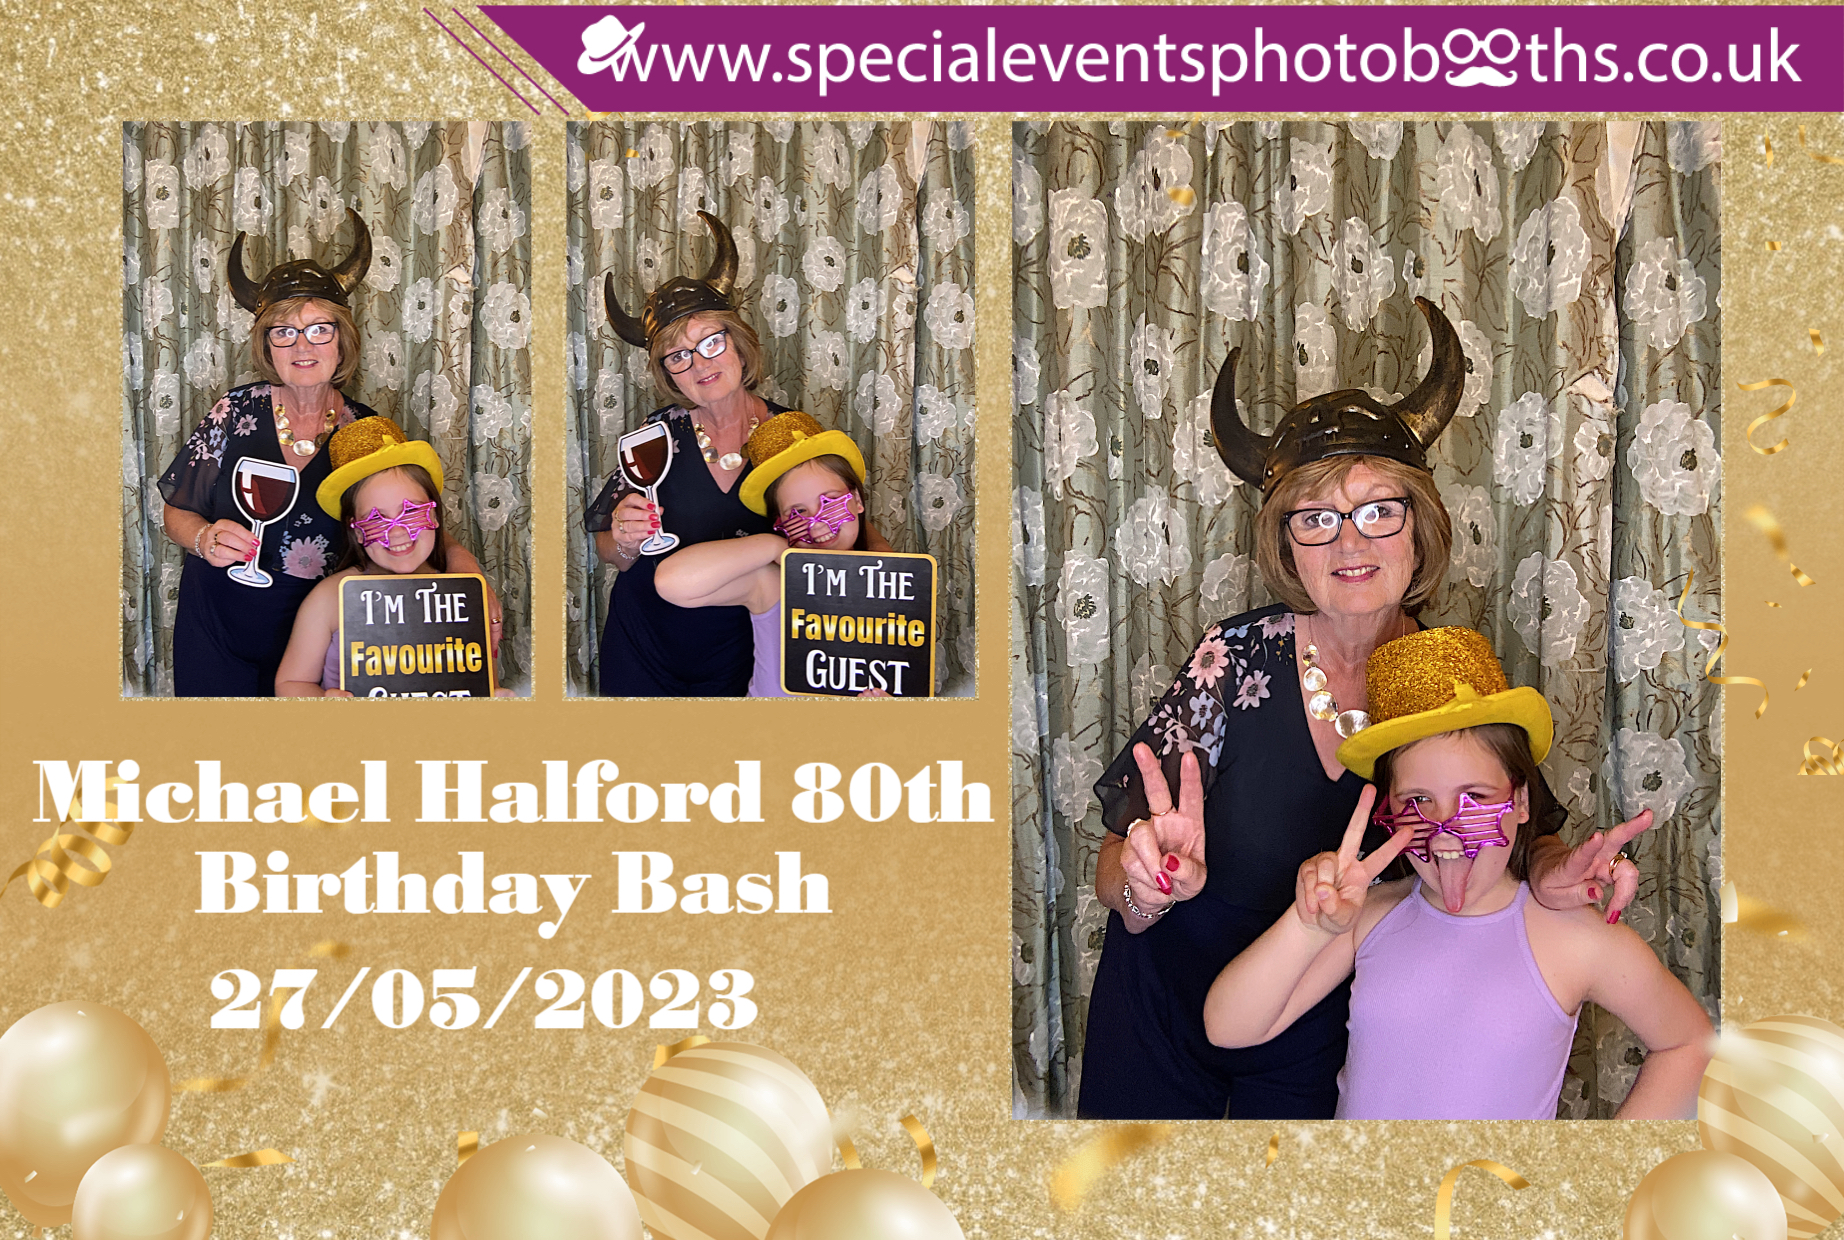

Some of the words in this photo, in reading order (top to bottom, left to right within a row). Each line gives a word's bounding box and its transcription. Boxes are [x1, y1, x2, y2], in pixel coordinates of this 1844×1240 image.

[802, 562, 847, 597] I'M
[858, 559, 915, 601] THE
[360, 590, 405, 625] I'M
[415, 581, 470, 623] THE
[791, 608, 925, 648] Favourite
[350, 636, 483, 677] Favourite
[805, 649, 911, 695] GUEST
